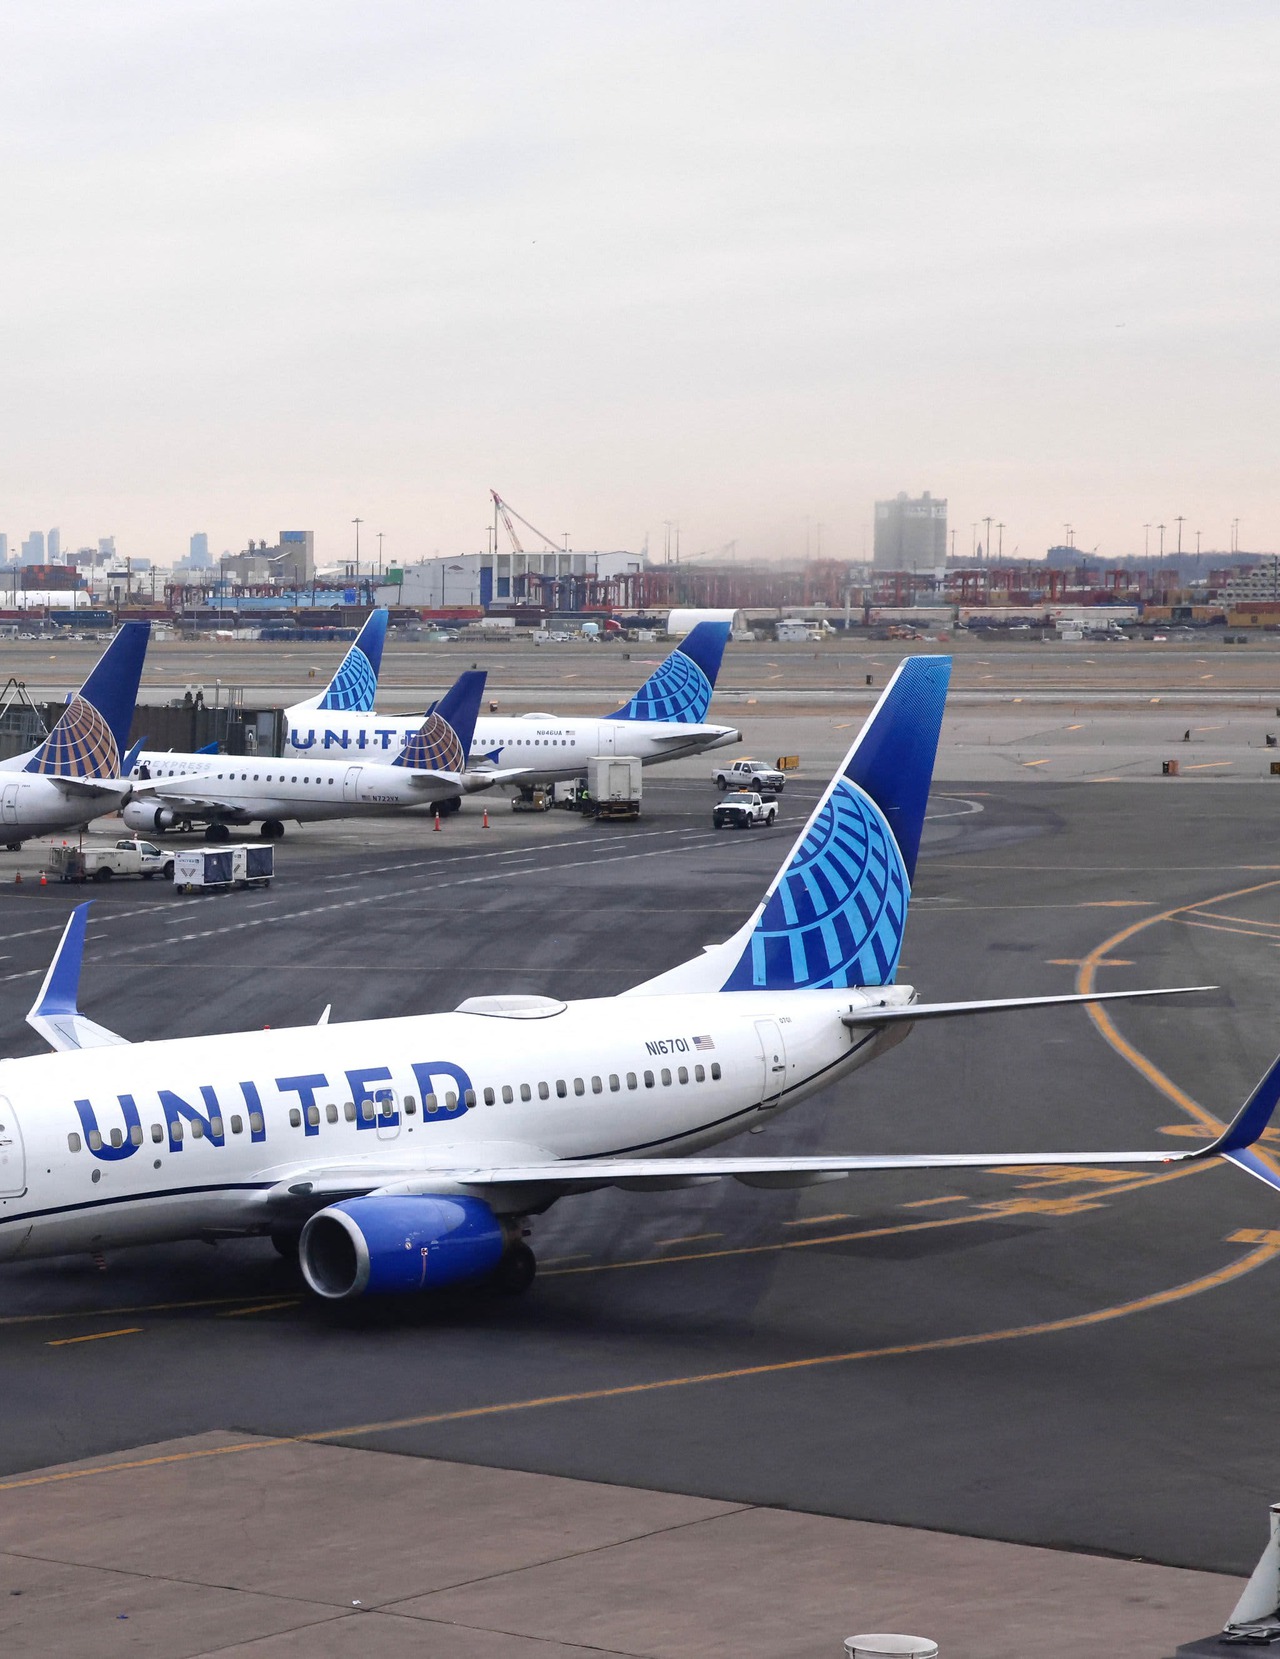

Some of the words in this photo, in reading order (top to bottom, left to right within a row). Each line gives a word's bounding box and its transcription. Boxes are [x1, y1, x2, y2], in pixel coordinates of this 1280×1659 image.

[291, 729, 420, 749] UNIT
[152, 760, 212, 771] EXPRESS
[645, 1037, 690, 1056] N16701
[73, 1061, 473, 1162] UNITED
